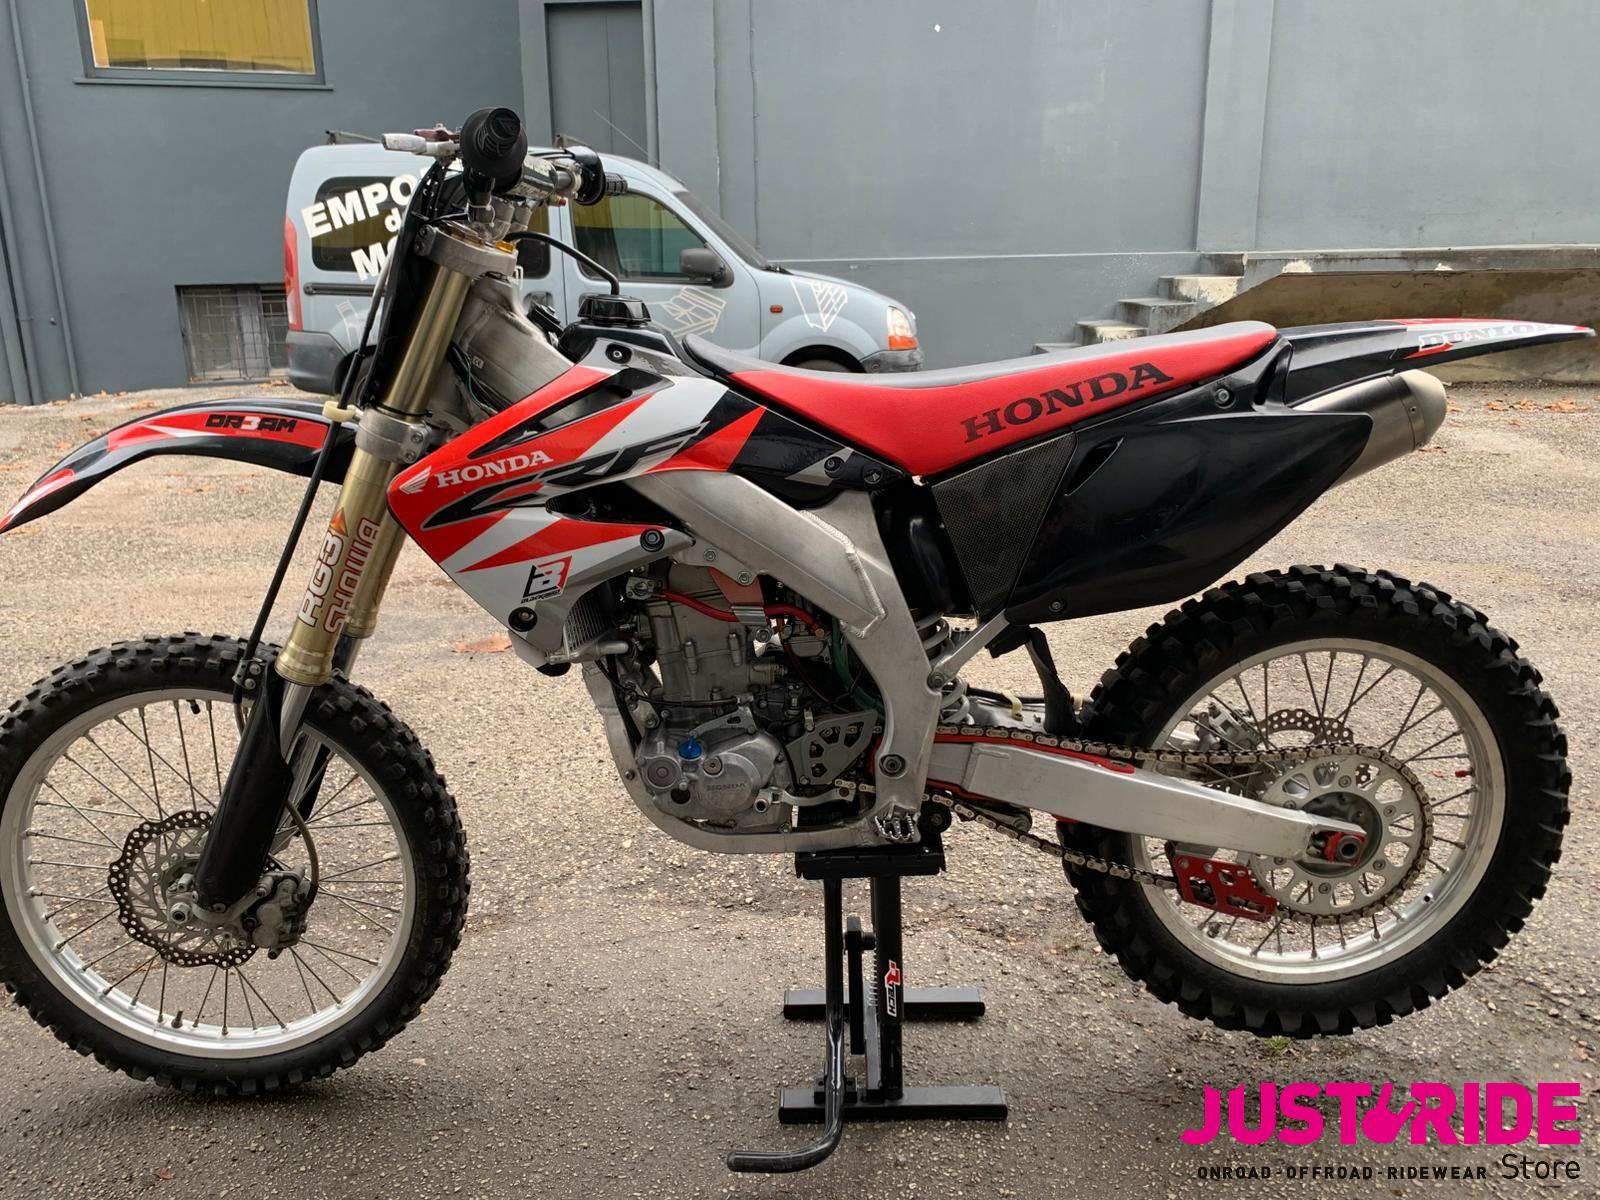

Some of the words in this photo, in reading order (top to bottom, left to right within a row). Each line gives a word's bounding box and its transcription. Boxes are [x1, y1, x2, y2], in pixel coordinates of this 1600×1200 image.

[301, 166, 430, 238] EMPO
[205, 414, 297, 433] DR3AM
[960, 362, 1174, 443] HONDA
[434, 450, 554, 489] HONDA
[298, 530, 344, 627] RG3
[323, 517, 380, 633] SHOWA
